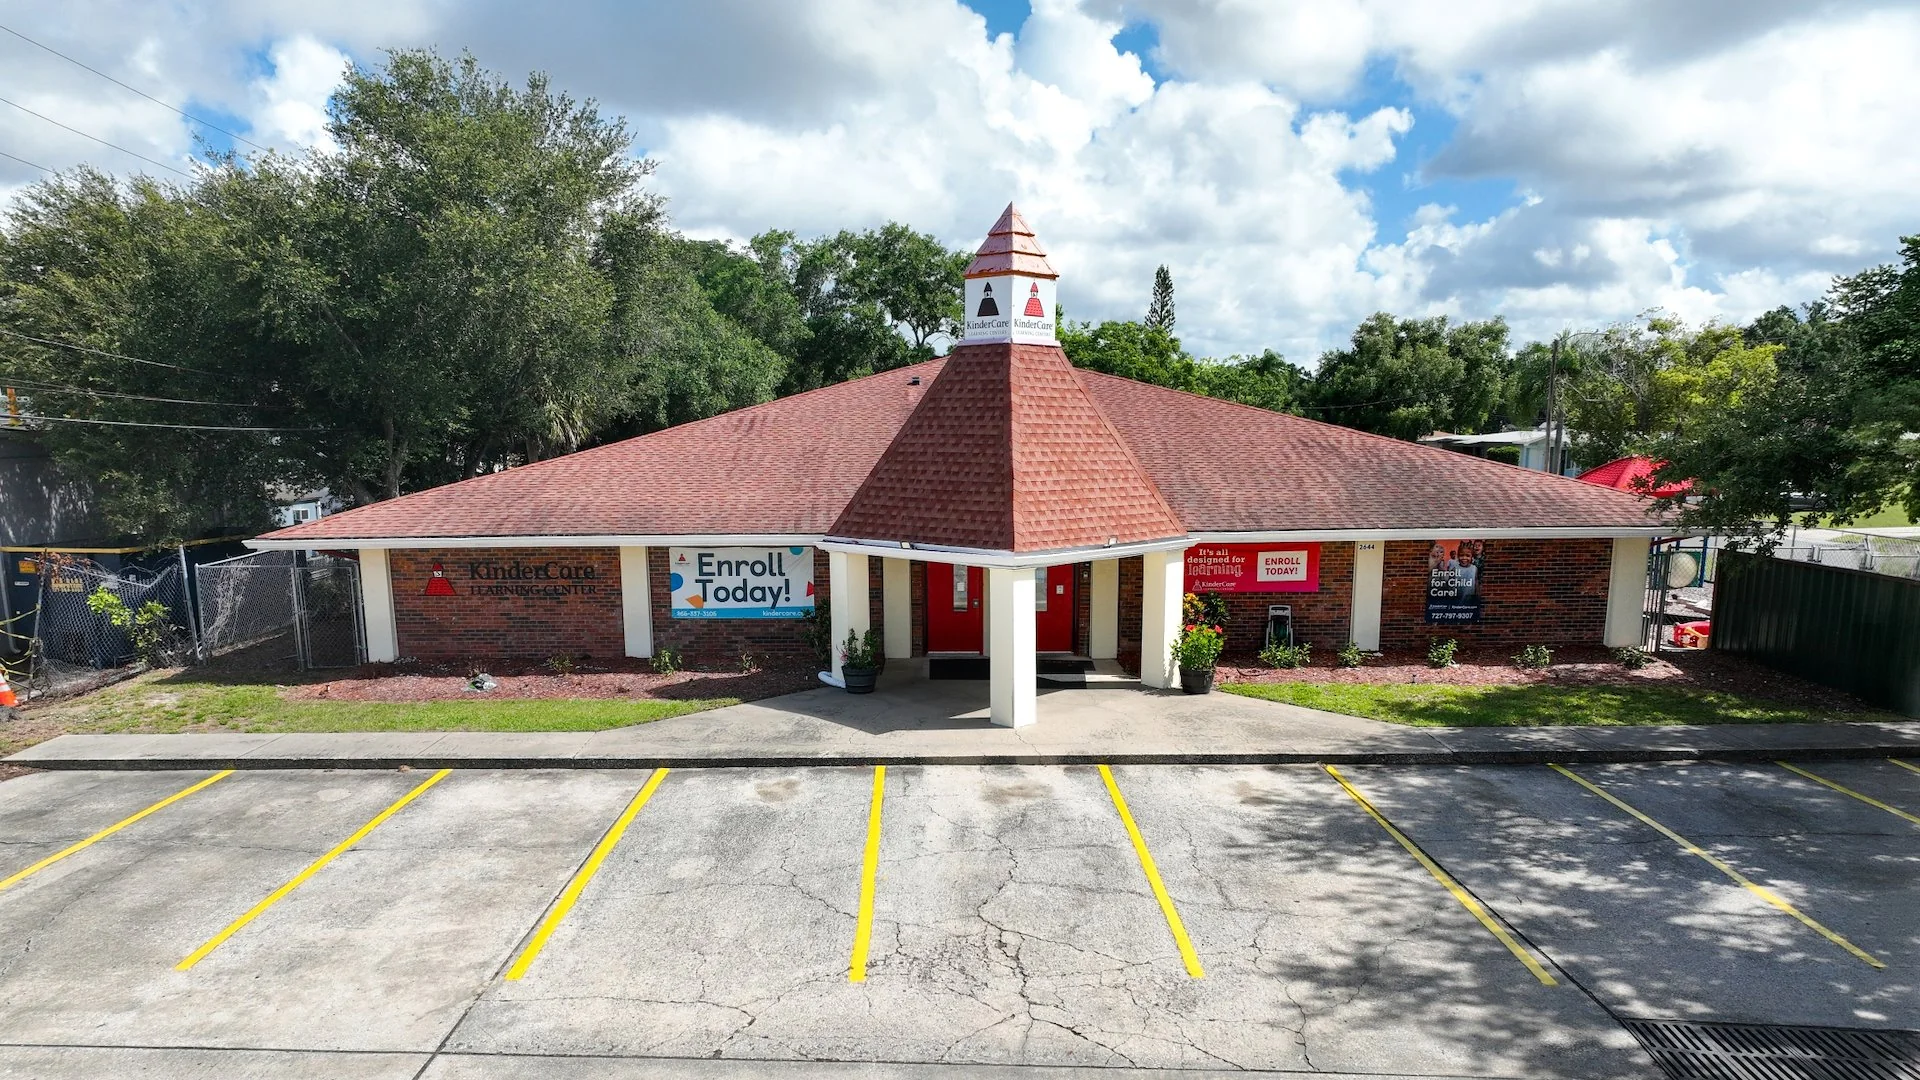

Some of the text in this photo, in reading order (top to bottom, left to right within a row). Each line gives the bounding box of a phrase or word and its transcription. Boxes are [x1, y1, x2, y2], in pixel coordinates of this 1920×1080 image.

[966, 319, 1010, 330] KinderCare
[1014, 318, 1054, 330] KinderCare
[697, 552, 786, 577] Enroll
[1187, 556, 1230, 565] designed
[1265, 557, 1301, 566] ENROLL
[469, 561, 595, 580] KinderCare
[1265, 567, 1298, 575] TODAY!
[1431, 569, 1461, 577] Enroll
[1431, 578, 1473, 587] for Child
[470, 584, 597, 595] LEARNING CENTER
[695, 579, 791, 609] Today!
[1430, 589, 1458, 597] Care!
